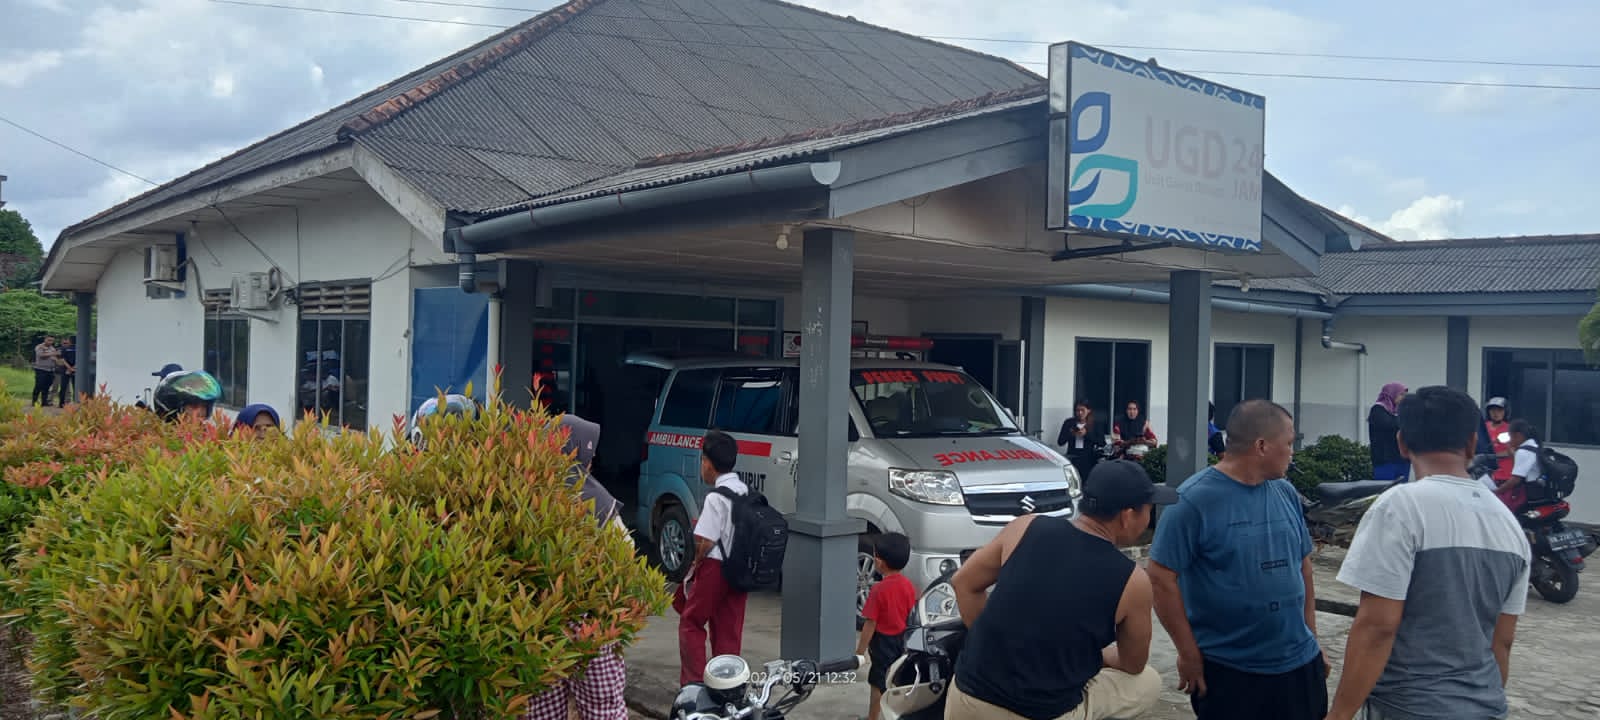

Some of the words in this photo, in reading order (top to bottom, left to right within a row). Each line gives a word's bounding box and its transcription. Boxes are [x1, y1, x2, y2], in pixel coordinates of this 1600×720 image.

[1145, 112, 1227, 179] UGD
[1231, 137, 1262, 177] 24
[649, 432, 703, 449] AMBULANCE
